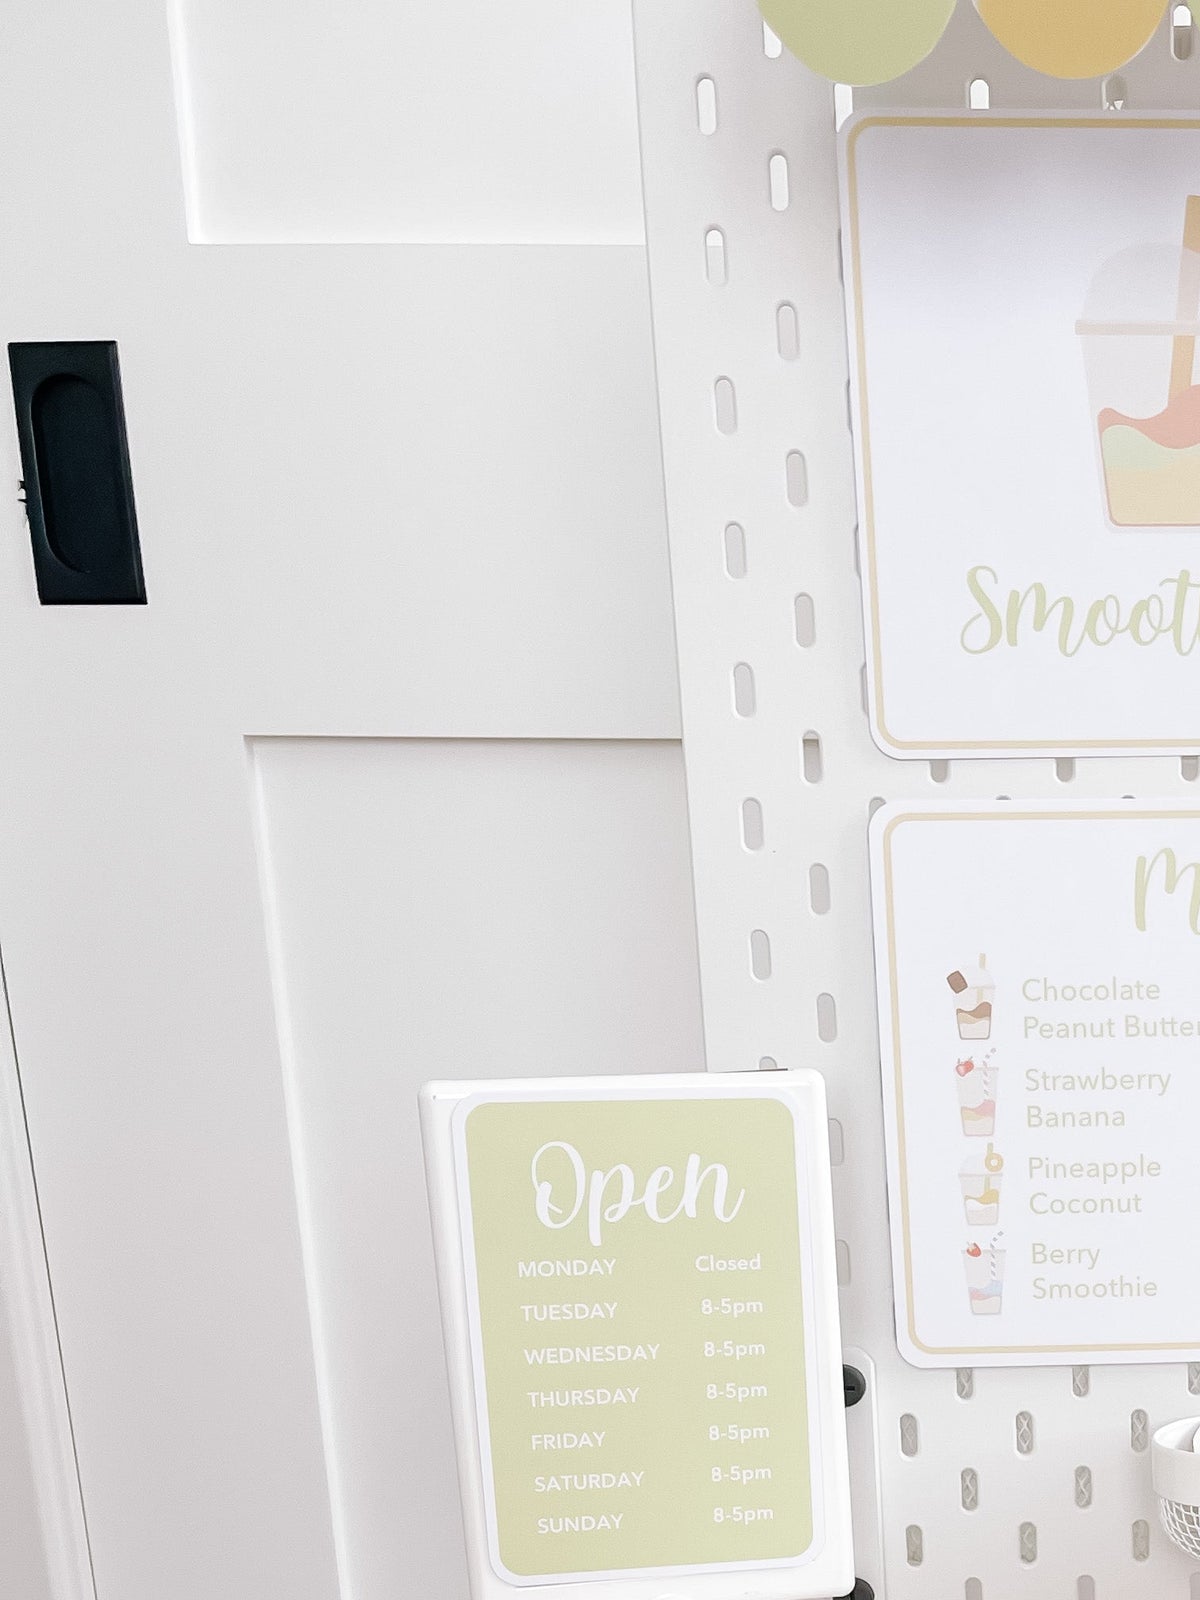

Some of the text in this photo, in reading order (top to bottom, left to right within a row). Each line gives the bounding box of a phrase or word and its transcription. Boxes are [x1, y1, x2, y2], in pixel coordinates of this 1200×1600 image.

[1022, 976, 1161, 1002] Chocolate
[1022, 1016, 1115, 1040] Peanut
[1025, 1066, 1171, 1098] Strawberry
[1027, 1106, 1126, 1129] Banana
[1029, 1154, 1161, 1186] Pineapple
[531, 1140, 745, 1246] Open
[1029, 1192, 1142, 1216] Coconut
[518, 1253, 762, 1278] MONDAY Closed
[1032, 1243, 1100, 1271] Berry
[1032, 1276, 1158, 1300] Smoothie
[521, 1298, 763, 1322] TUESDAY 8-5pm
[525, 1340, 765, 1365] WEDNESDAY 8-5pm
[528, 1382, 768, 1408] THURSDAY 8-5pm
[531, 1424, 769, 1450] FRIDAY 8-5pm
[535, 1465, 772, 1492] SATURDAY 8-5pm
[537, 1506, 774, 1534] SUNDAY 8-5pm
